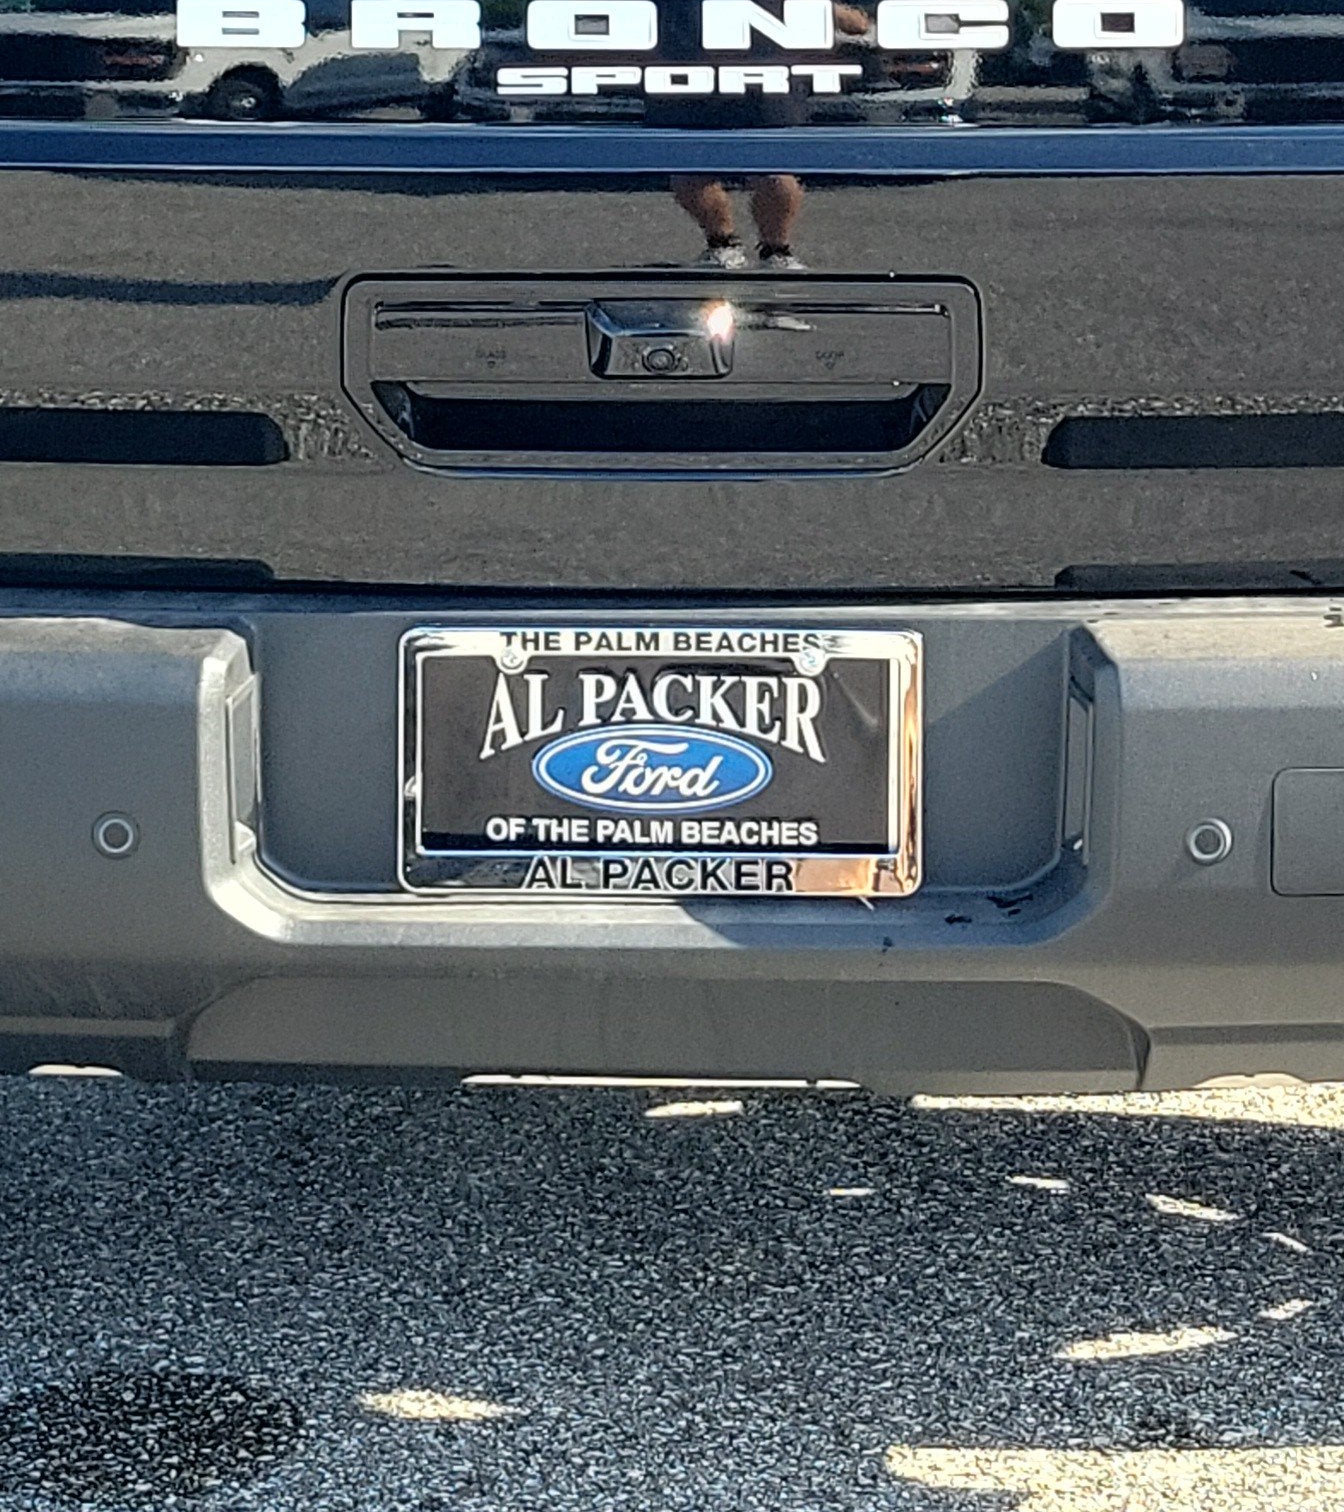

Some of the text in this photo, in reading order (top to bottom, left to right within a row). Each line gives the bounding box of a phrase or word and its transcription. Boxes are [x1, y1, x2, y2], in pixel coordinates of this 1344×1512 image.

[496, 64, 863, 95] SPORT
[499, 631, 822, 653] THE PALM BEACHES
[479, 671, 827, 764] AL PACKER
[580, 738, 725, 797] Ford
[485, 816, 819, 846] OF THE PALM BEACHES
[523, 855, 795, 892] AL PACKER
